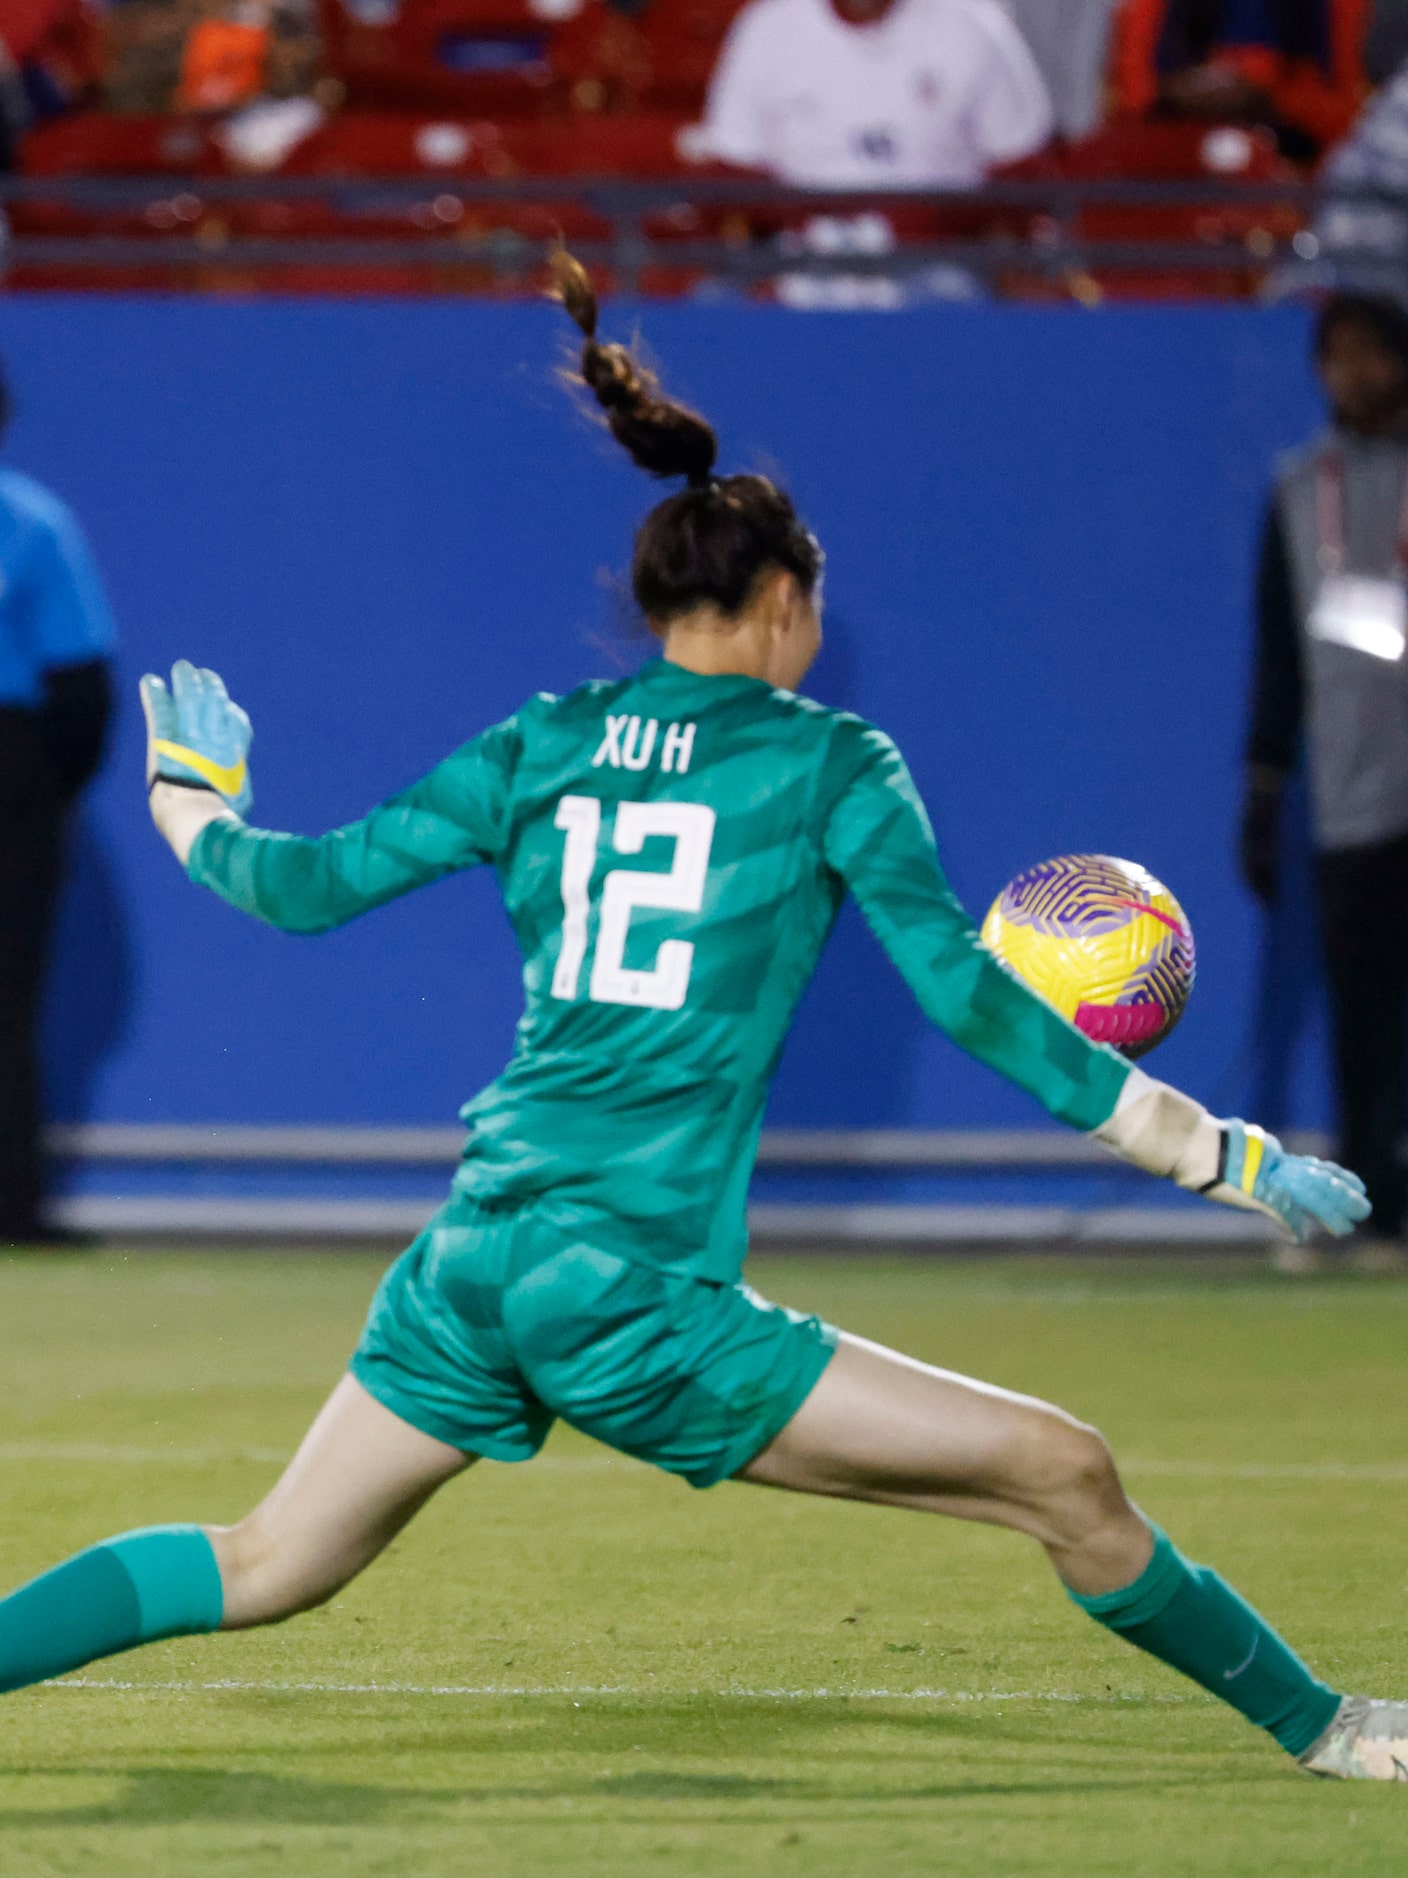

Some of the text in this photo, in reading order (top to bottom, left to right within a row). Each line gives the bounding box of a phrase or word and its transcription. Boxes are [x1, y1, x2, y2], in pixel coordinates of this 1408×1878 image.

[593, 714, 697, 774] XU H
[550, 794, 717, 1011] 12
